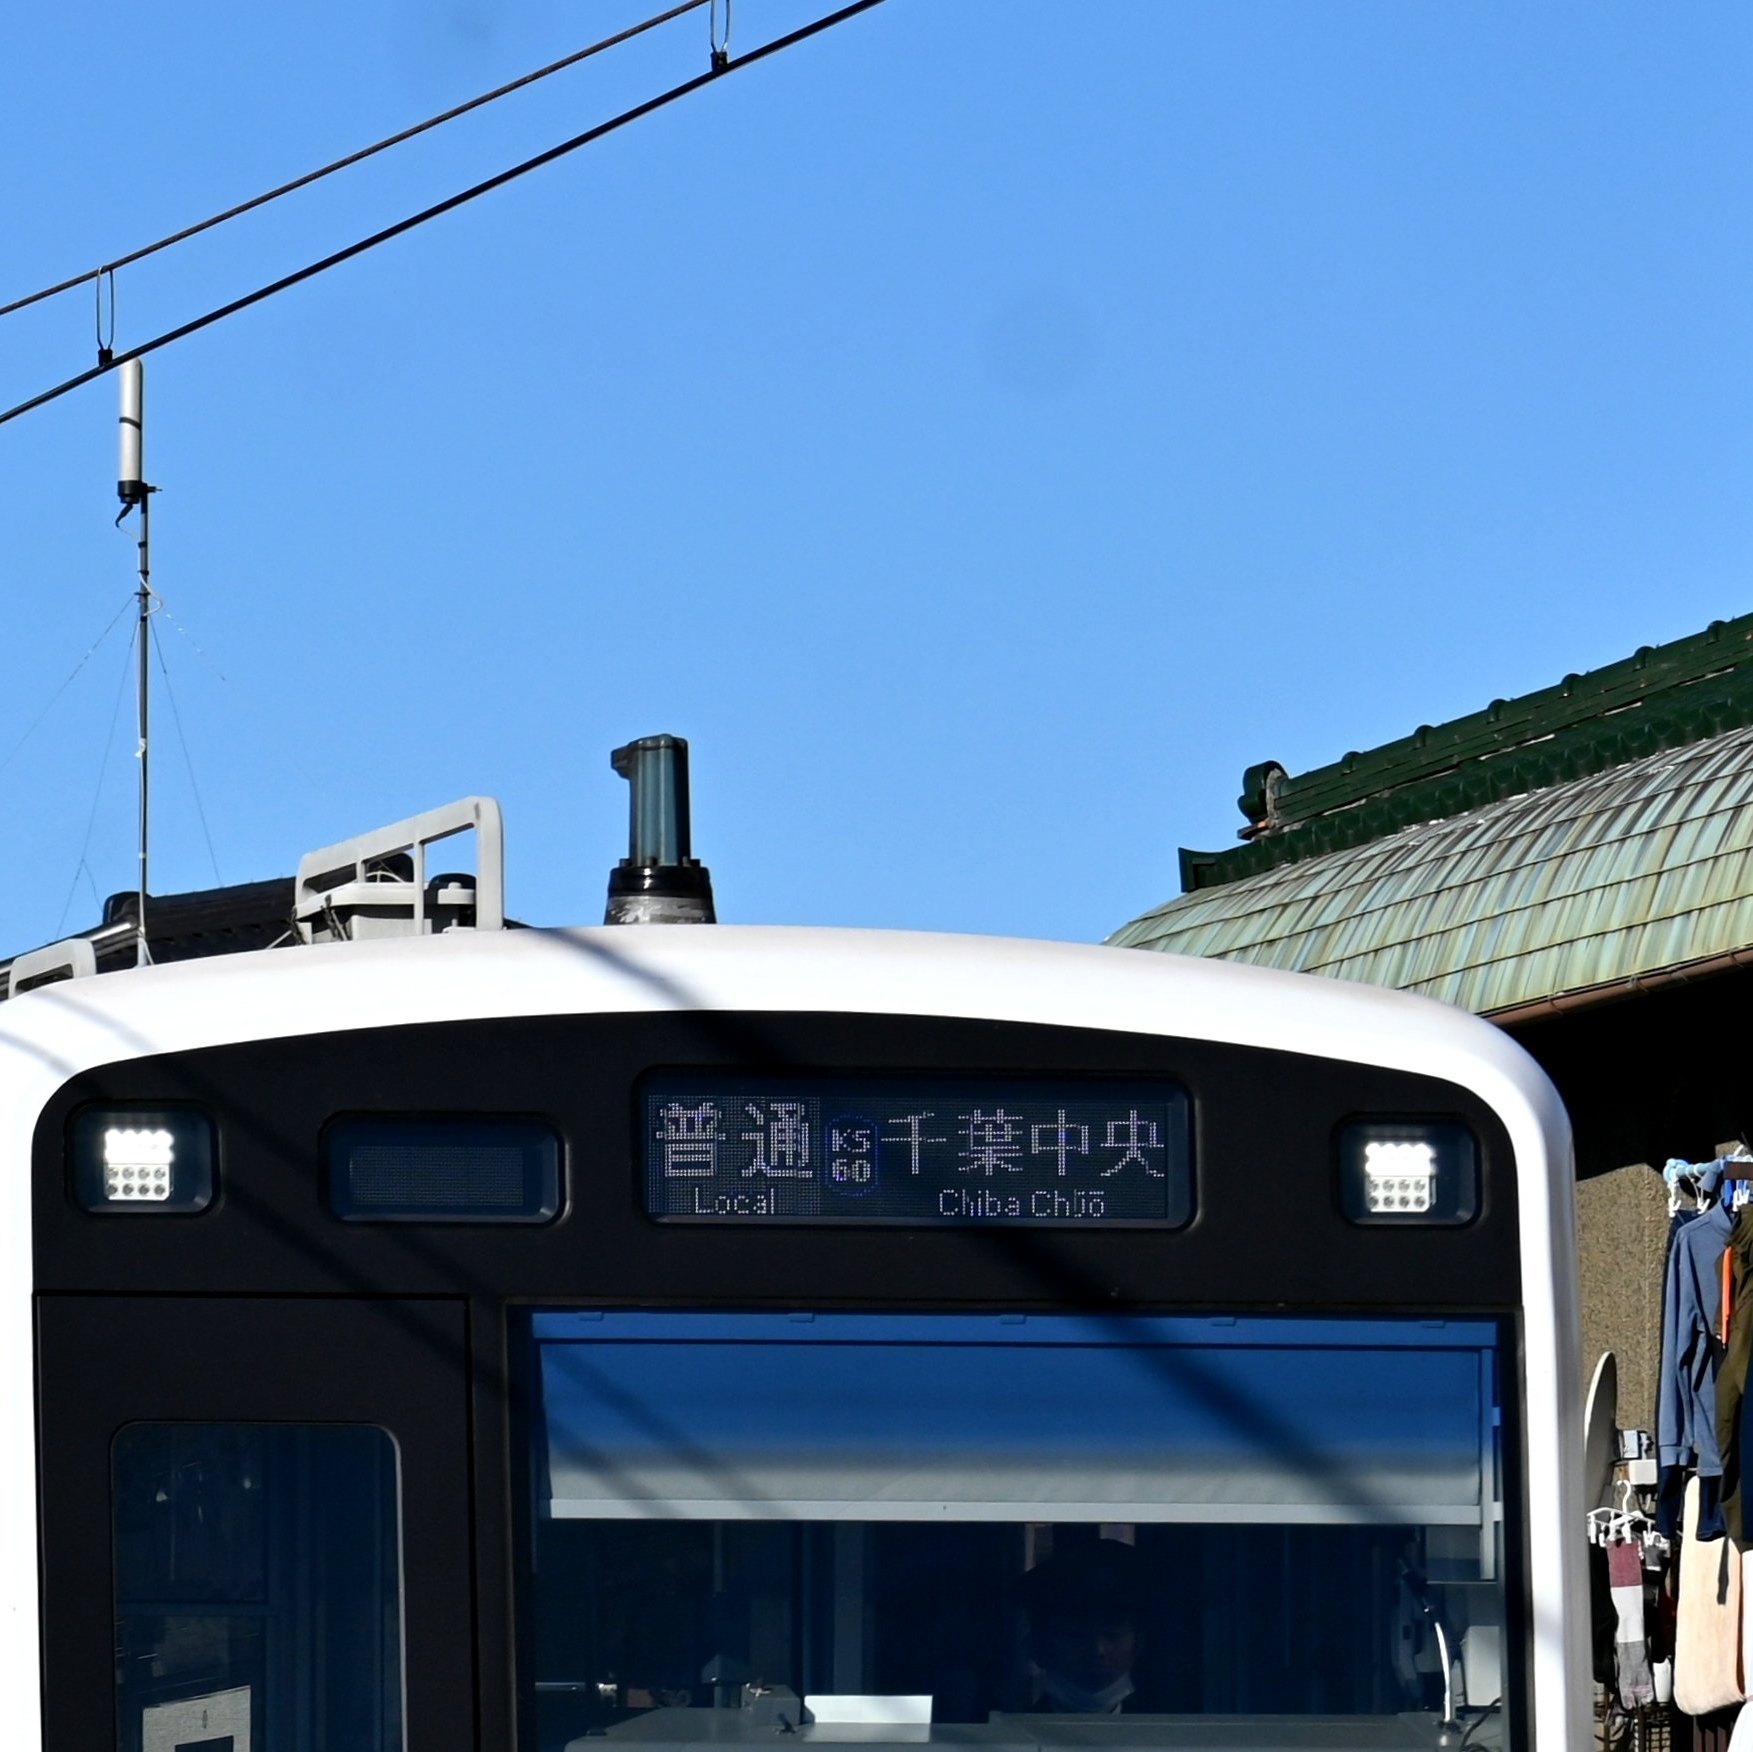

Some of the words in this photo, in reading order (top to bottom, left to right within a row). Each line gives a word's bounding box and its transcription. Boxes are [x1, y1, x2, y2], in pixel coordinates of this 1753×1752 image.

[655, 1102, 814, 1179] 普通
[831, 1128, 871, 1152] KS
[881, 1108, 1165, 1178] 千葉中央
[831, 1158, 871, 1182] 60
[694, 1187, 774, 1215] Local
[938, 1188, 1021, 1216] Chiba
